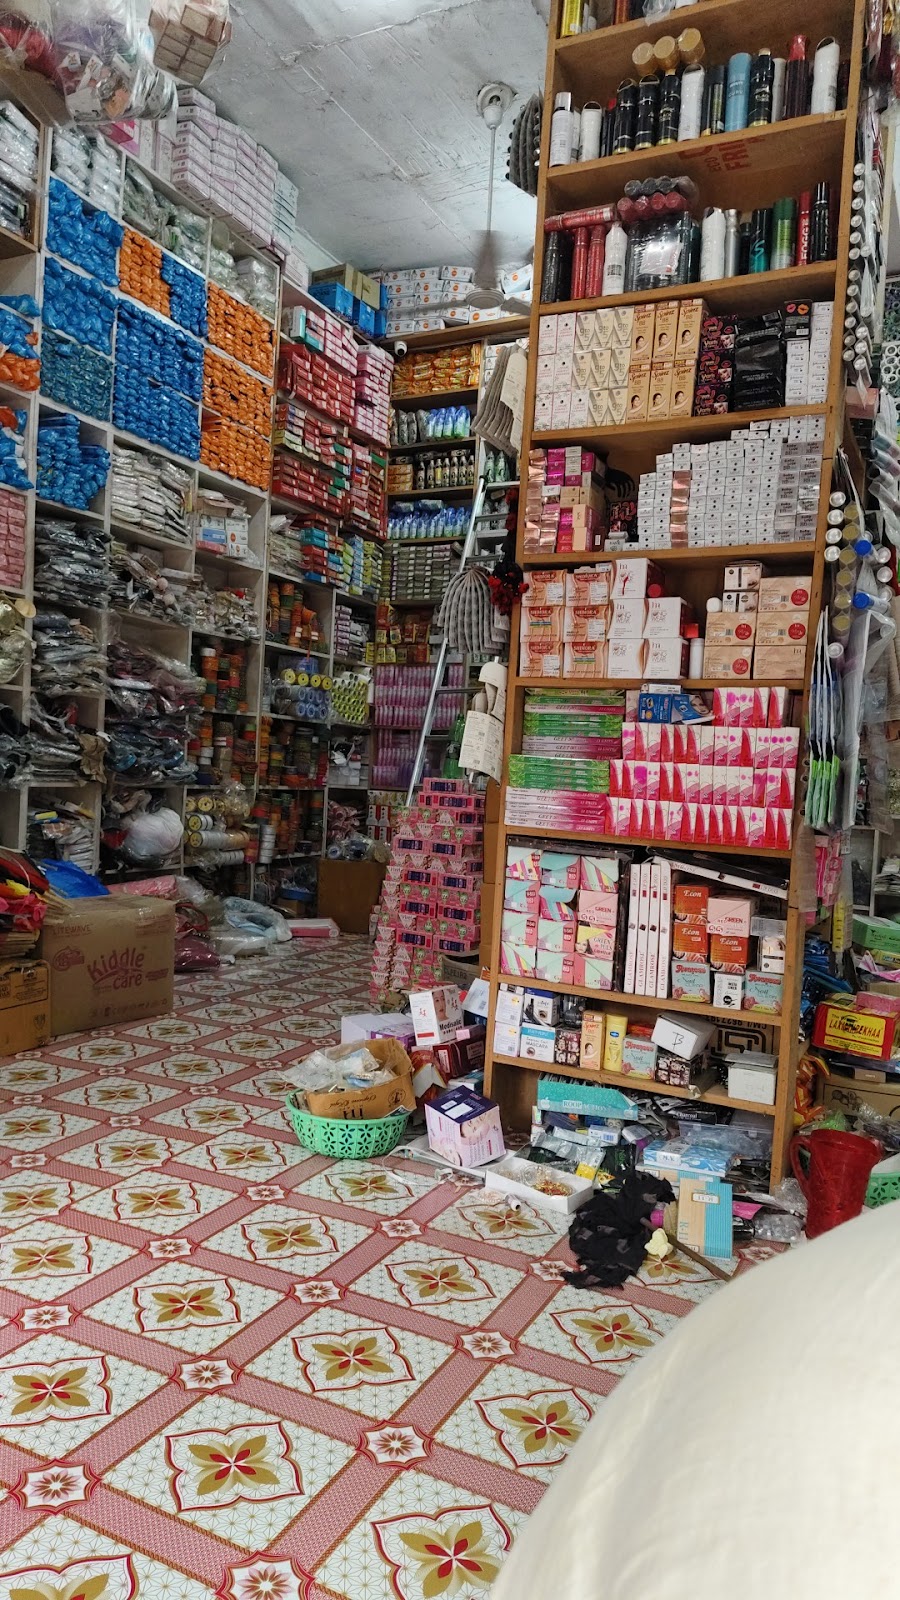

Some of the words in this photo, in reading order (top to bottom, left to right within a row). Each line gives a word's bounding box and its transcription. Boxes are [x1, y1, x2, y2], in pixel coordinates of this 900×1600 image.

[683, 889, 702, 898] Econ
[595, 906, 612, 914] GREEN
[681, 927, 700, 937] Econ
[719, 937, 739, 946] Econ
[87, 947, 145, 982] Kiddle
[113, 973, 143, 990] care
[677, 1111, 698, 1119] Charcoal
